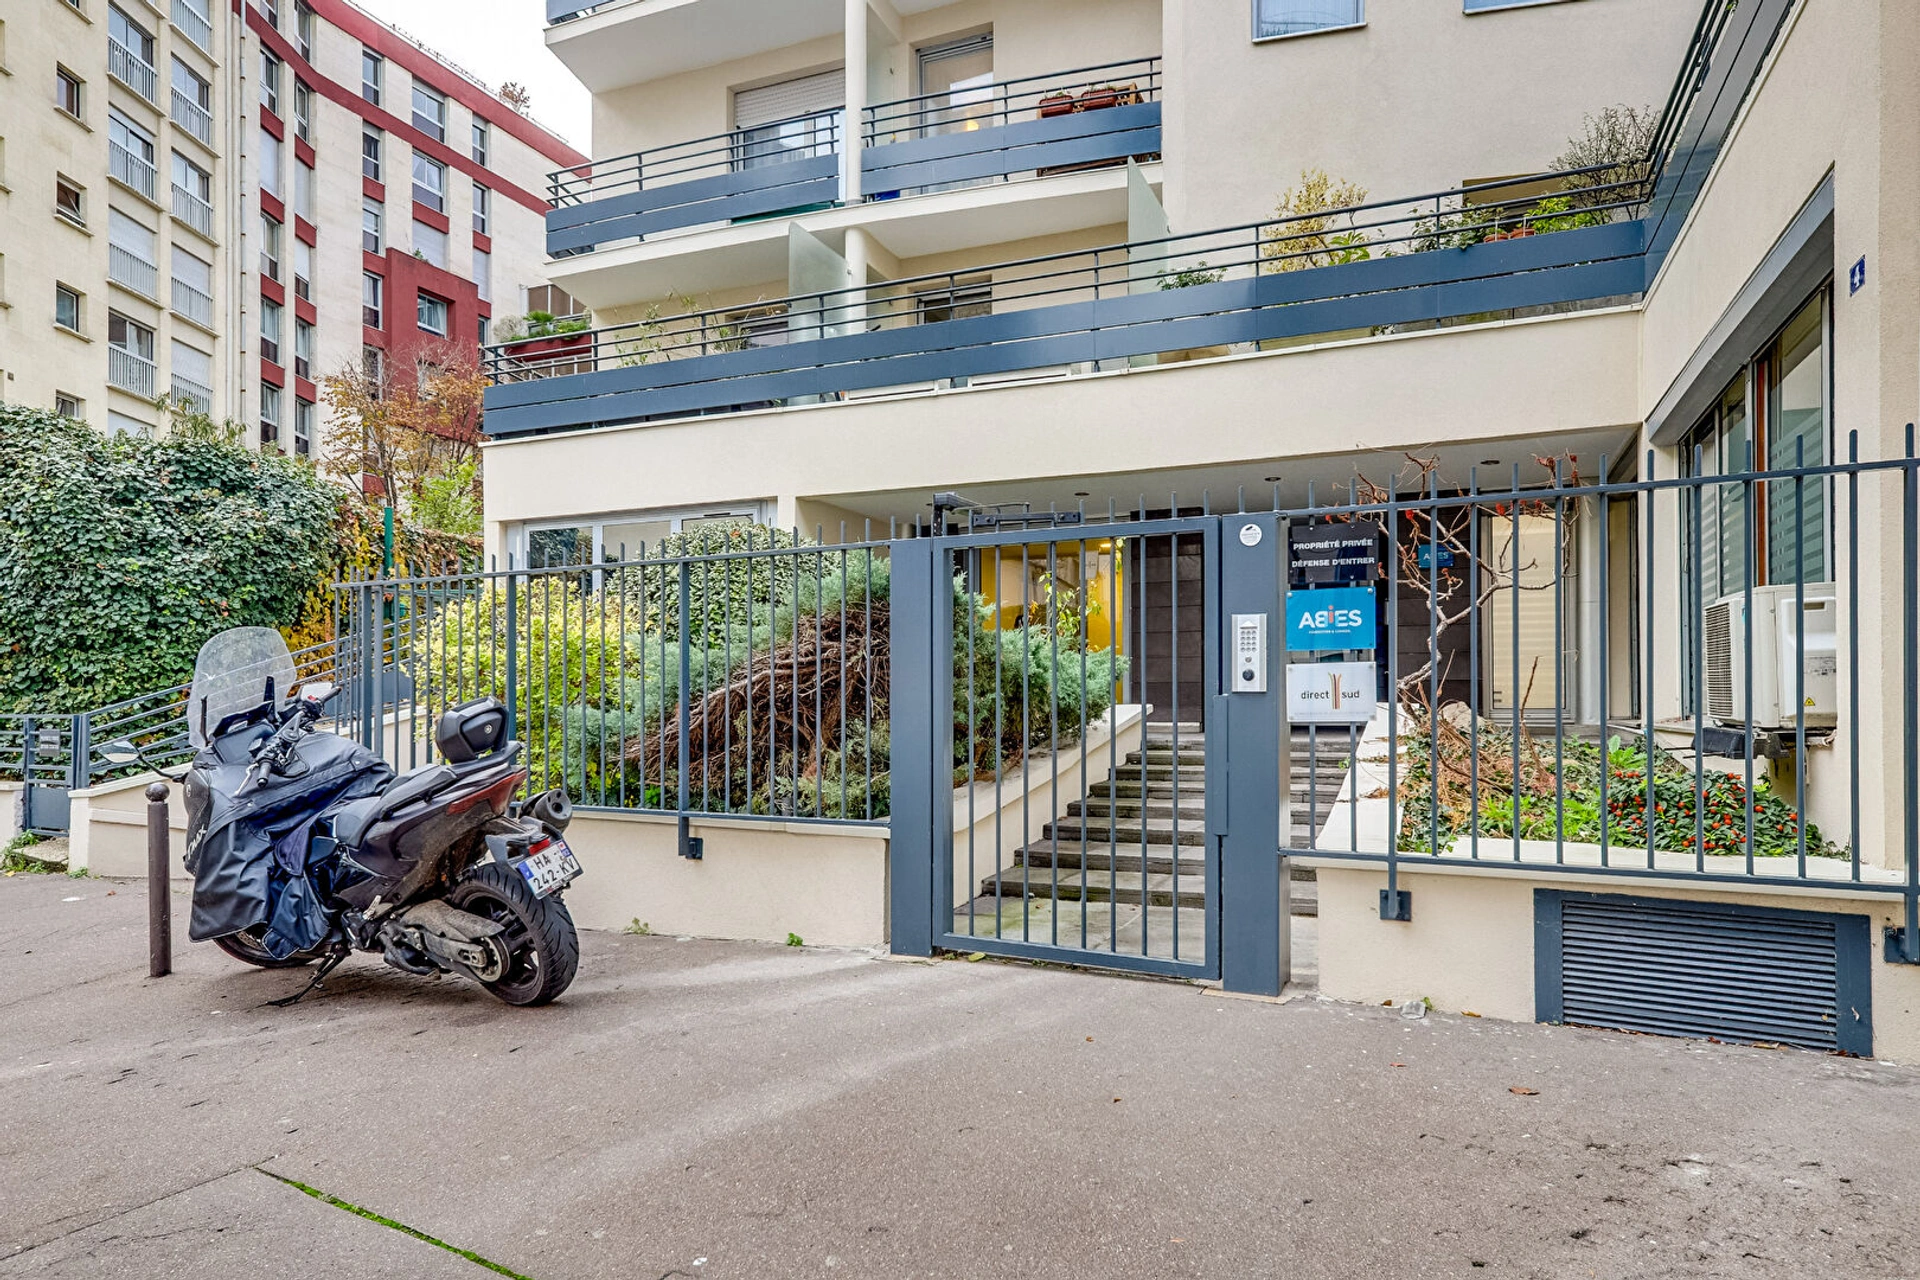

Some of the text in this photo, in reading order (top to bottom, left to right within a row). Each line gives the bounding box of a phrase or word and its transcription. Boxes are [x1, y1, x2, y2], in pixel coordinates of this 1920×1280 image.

[1853, 264, 1861, 288] 4
[1293, 538, 1373, 550] PROPRIÉTÉ PRIVÉE
[1291, 557, 1375, 568] DÉFENSE D'ENTRER
[1301, 689, 1360, 699] direct sud
[533, 858, 575, 890] 242-KV
